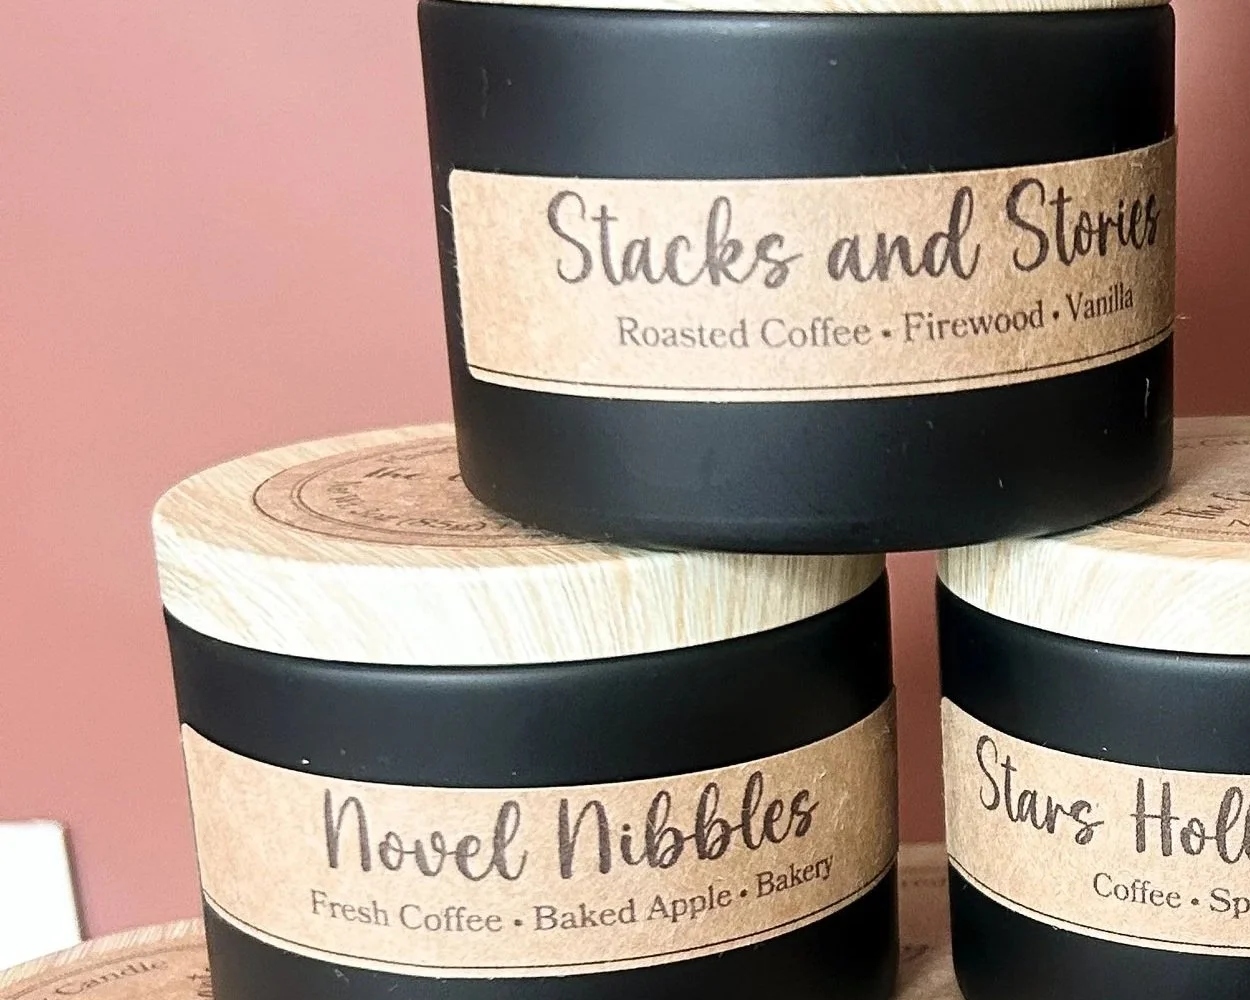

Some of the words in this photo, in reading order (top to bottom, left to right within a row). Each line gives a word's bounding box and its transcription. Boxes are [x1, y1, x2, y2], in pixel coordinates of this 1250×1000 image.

[547, 190, 802, 288] Stacks
[828, 186, 986, 283] and
[1006, 178, 1161, 272] Stories
[617, 314, 749, 349] Roasted
[761, 314, 872, 348] Coffee
[903, 299, 1044, 344] Firewood
[1066, 281, 1134, 322] Vanilla
[322, 787, 530, 885] Novel
[558, 770, 820, 881] Nibbles
[975, 735, 1105, 847] Stars
[309, 889, 390, 929] Fresh
[400, 901, 504, 934] Coffee
[534, 896, 638, 932] Baked
[647, 883, 734, 930] Apple
[755, 852, 834, 900] Bakery
[1092, 871, 1182, 911] Coffee
[55, 961, 170, 995] Candle
